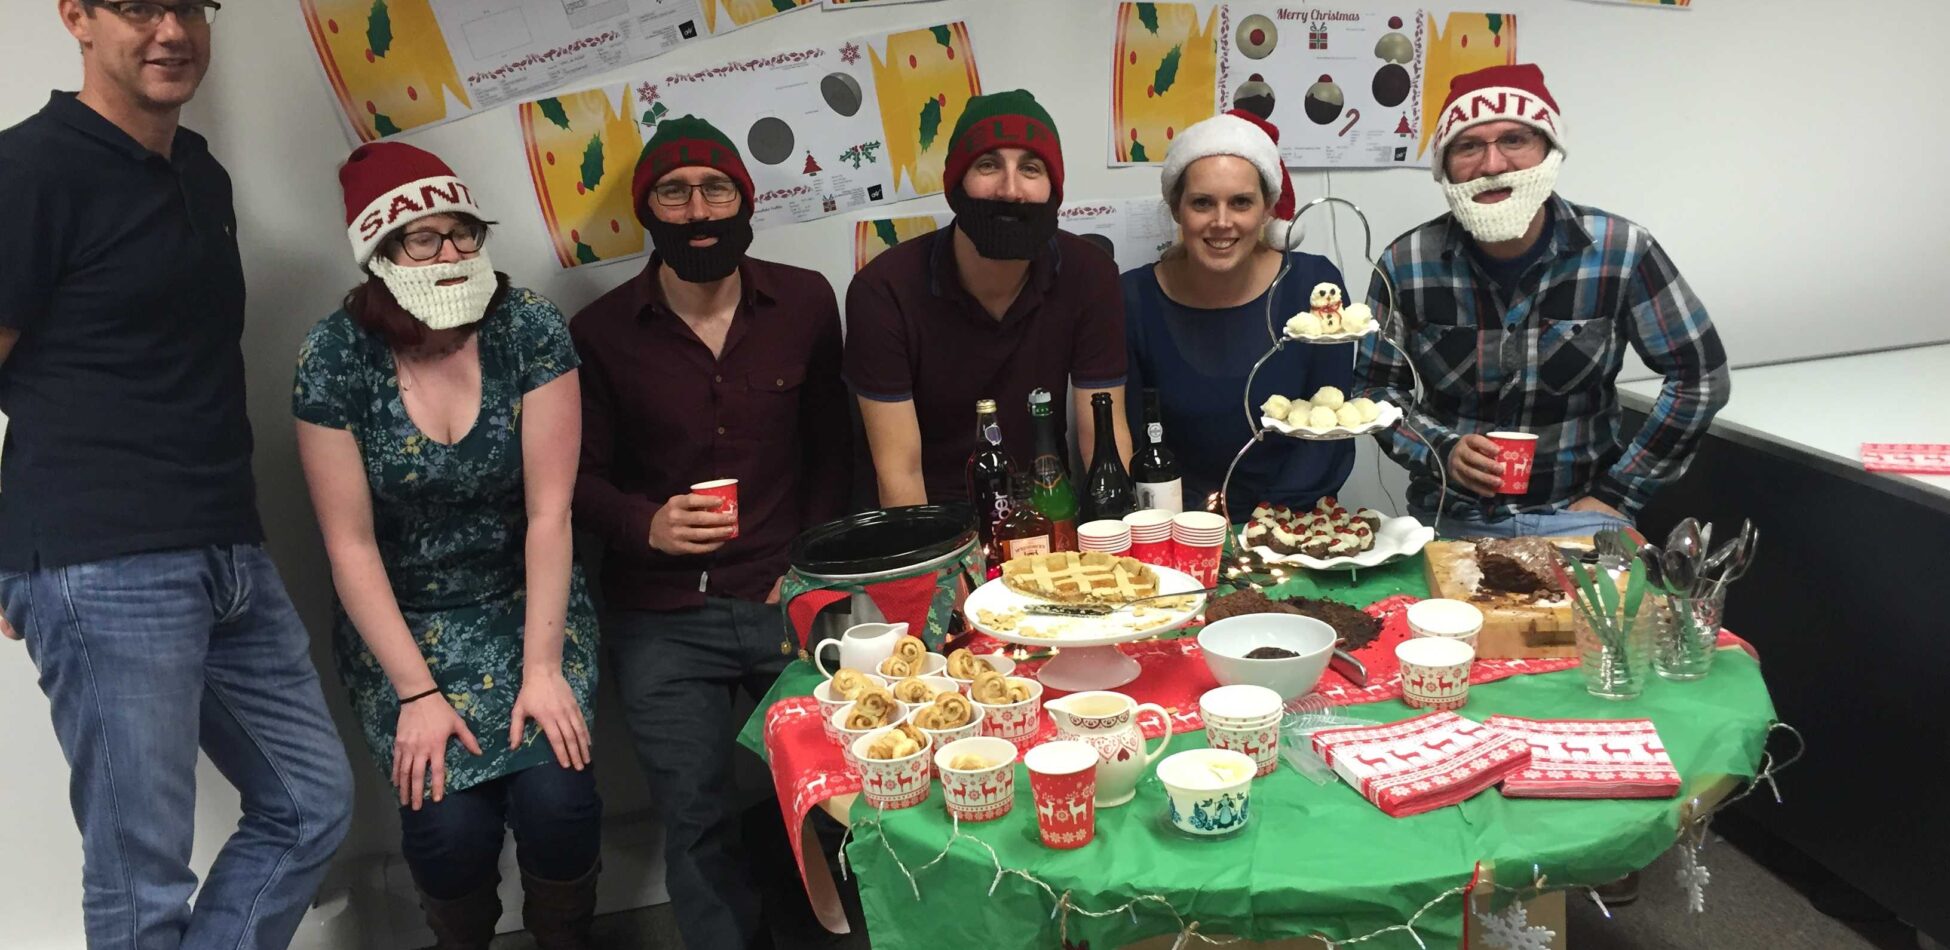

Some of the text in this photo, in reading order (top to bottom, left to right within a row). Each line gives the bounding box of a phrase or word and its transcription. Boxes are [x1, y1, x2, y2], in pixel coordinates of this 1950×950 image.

[1277, 8, 1360, 24] Merry Christmas
[360, 181, 479, 241] SANT
